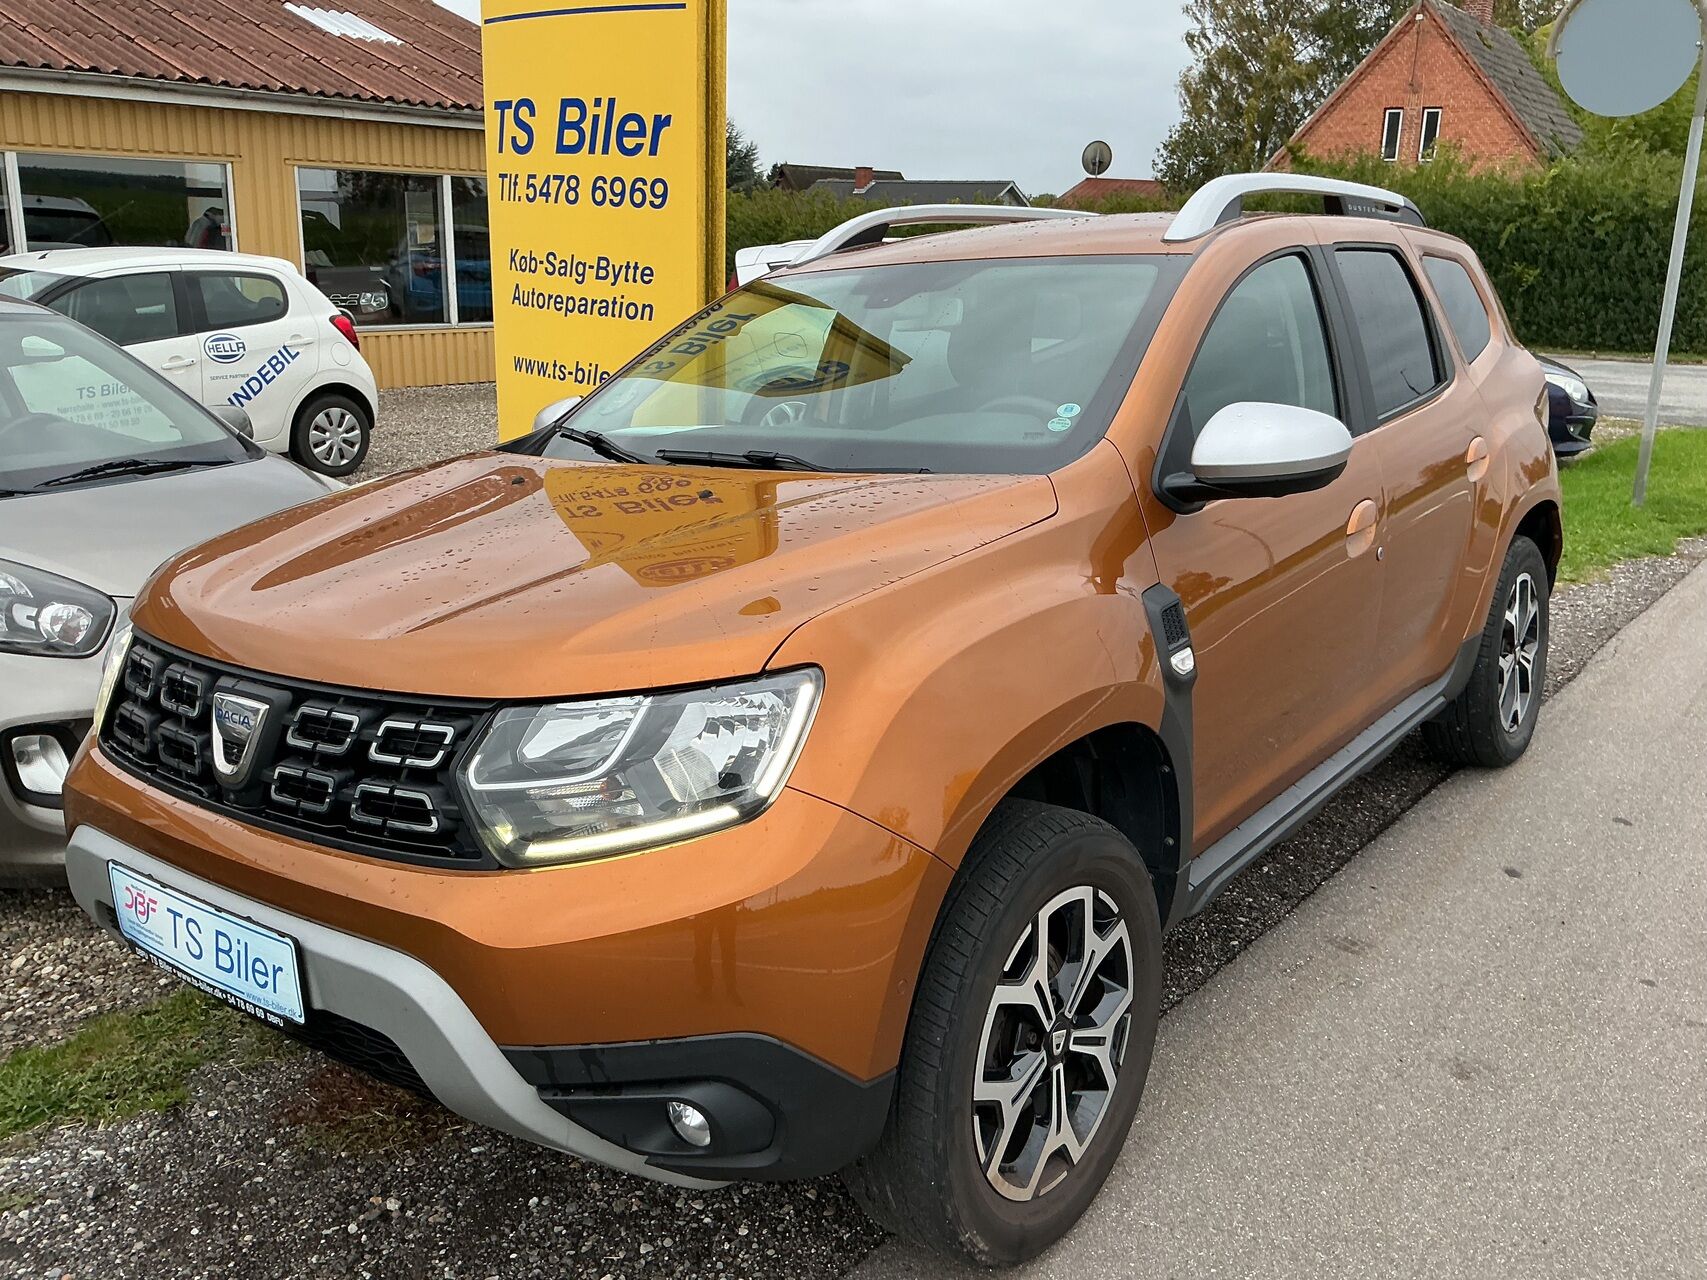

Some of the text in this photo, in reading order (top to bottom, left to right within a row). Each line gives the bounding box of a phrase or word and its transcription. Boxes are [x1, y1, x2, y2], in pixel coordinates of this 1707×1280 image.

[494, 97, 671, 157] TS Biler
[498, 173, 669, 210] Tlf. 5478 6969
[1347, 203, 1376, 213] DUSTER
[509, 248, 655, 287] Køb-Salg-Bytte
[511, 283, 655, 321] Autoreparation
[207, 341, 247, 354] HELLA
[76, 386, 96, 400] TS
[227, 344, 300, 408] NDEBIL
[216, 708, 252, 728] DACIA
[166, 907, 284, 994] TS Biler
